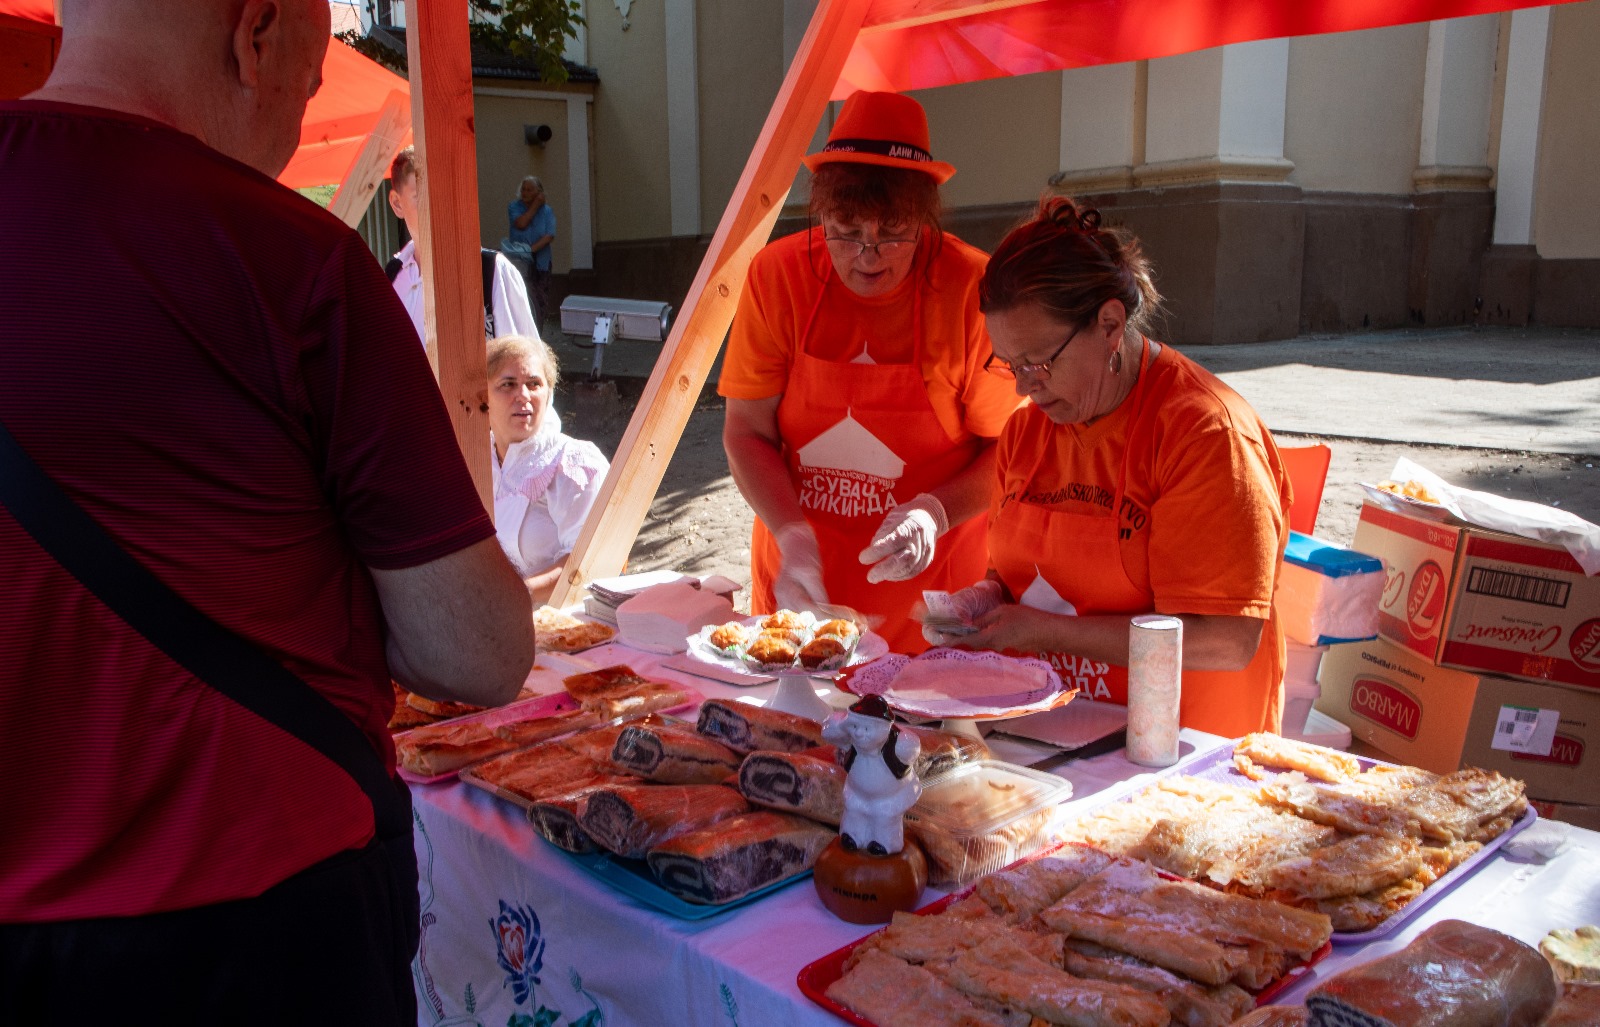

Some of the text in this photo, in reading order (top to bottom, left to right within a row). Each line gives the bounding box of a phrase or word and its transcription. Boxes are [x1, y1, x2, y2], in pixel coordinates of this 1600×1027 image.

[888, 144, 913, 158] ДАНИ
[799, 489, 898, 518] КИКИНДА
[1409, 569, 1440, 629] 7 DAYS
[1457, 624, 1562, 653] Croissant
[1361, 651, 1392, 671] PEPSICO
[1398, 665, 1421, 681] company
[1356, 686, 1415, 731] MARBO
